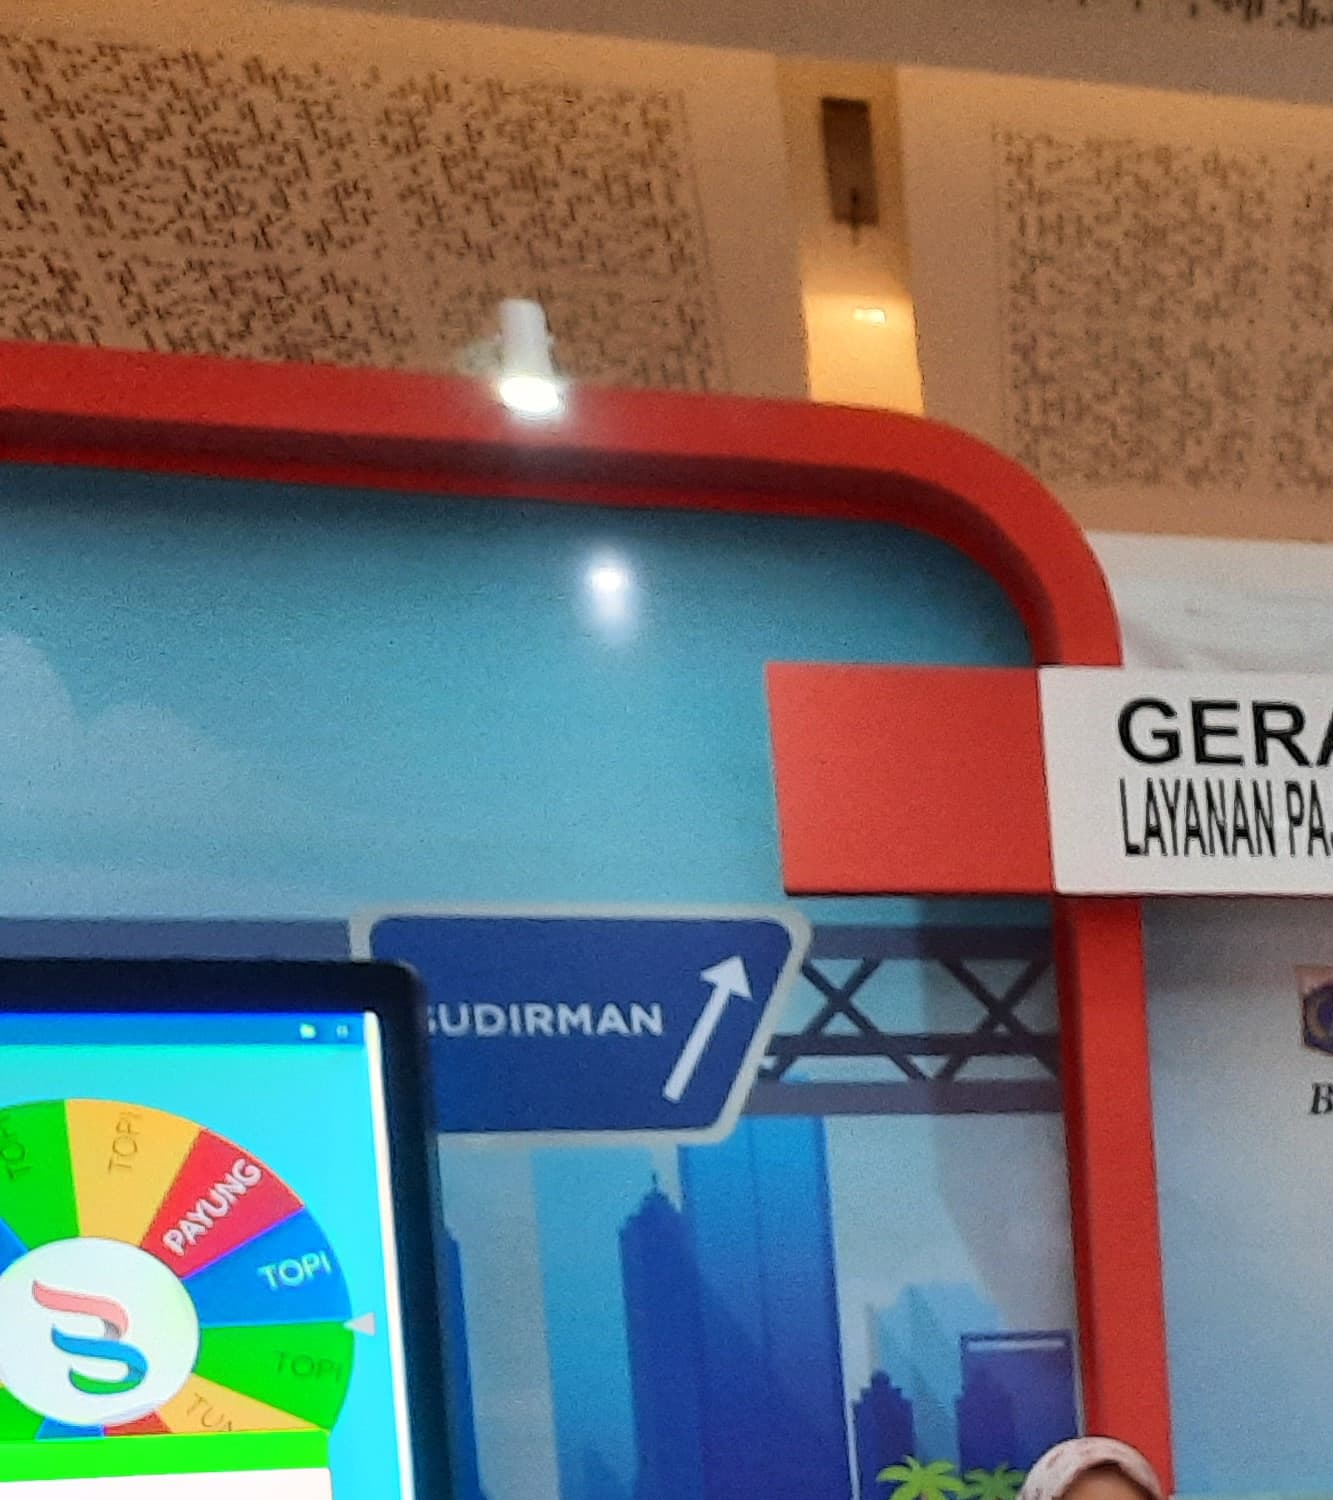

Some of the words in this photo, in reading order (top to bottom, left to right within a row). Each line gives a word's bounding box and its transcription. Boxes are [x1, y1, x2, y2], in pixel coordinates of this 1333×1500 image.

[1119, 777, 1277, 857] LAYANAN
[107, 1111, 144, 1174] TOPI
[162, 1157, 262, 1256] PAYUNG
[258, 1251, 332, 1290] TOPI
[275, 1350, 343, 1382] TOPI
